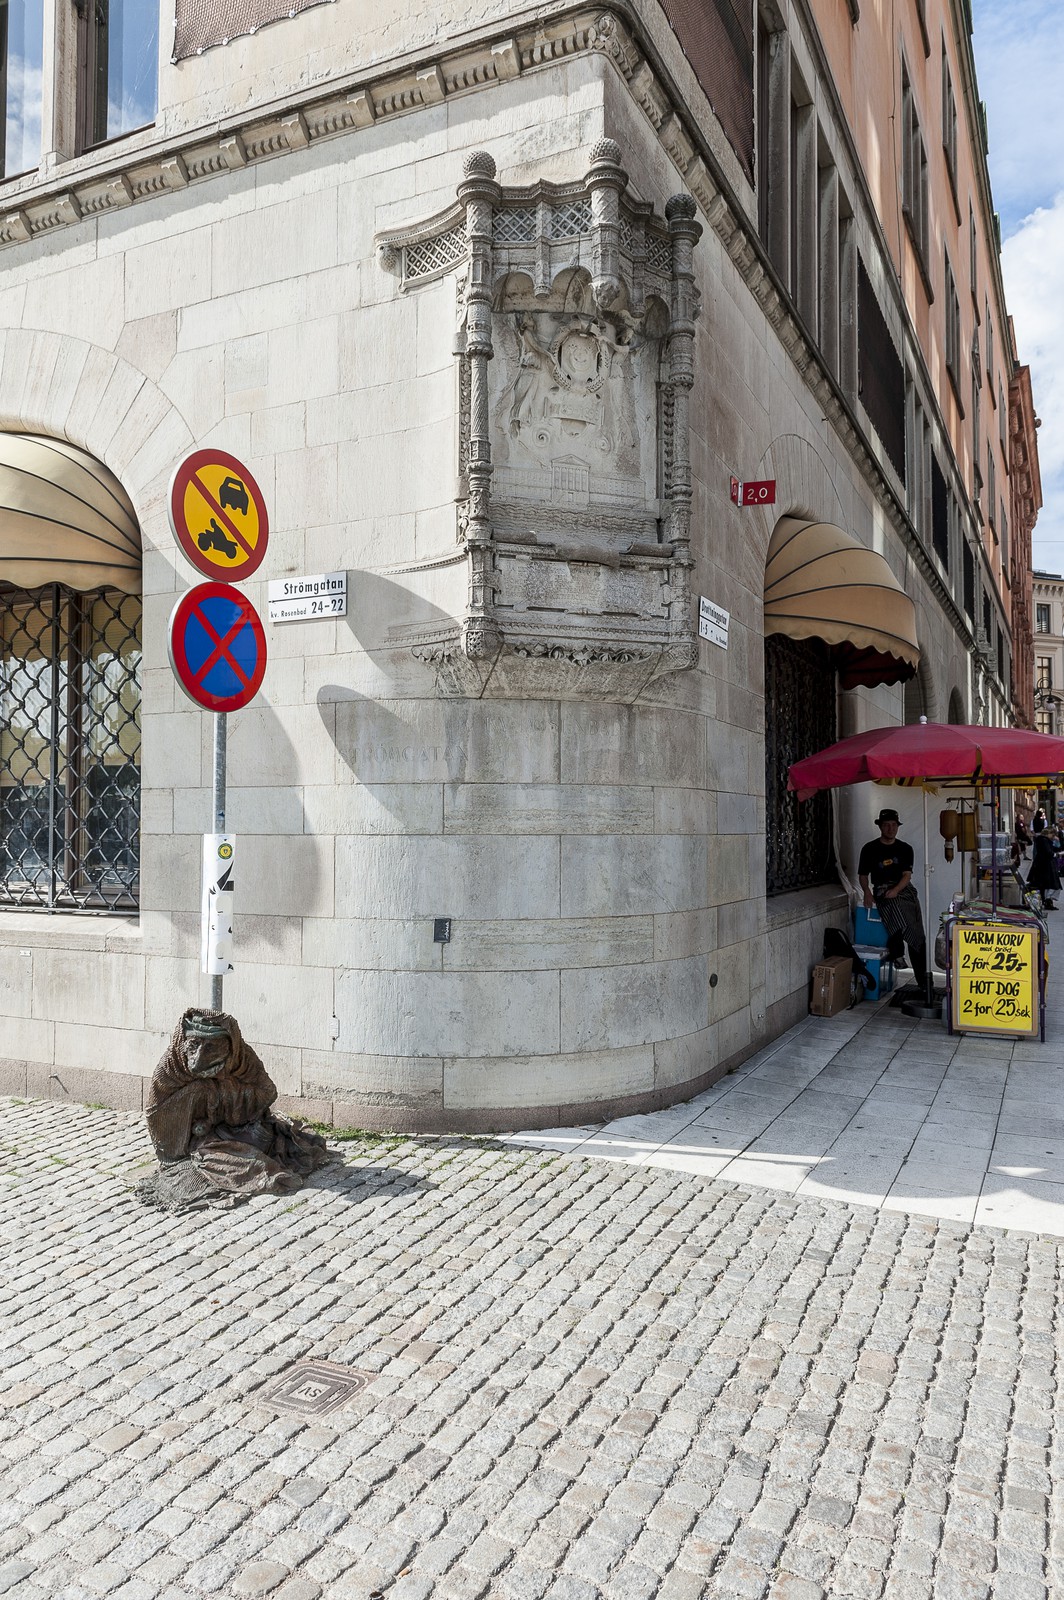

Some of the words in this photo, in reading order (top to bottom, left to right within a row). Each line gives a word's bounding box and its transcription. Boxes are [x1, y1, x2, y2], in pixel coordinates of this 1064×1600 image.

[747, 487, 768, 503] 2,0
[284, 579, 343, 595] Strömgatan
[311, 598, 344, 614] 24-22
[963, 931, 994, 945] VARM
[996, 933, 1024, 947] KORV
[961, 954, 971, 969] 2
[971, 957, 989, 972] för
[969, 980, 994, 995] HOT
[995, 981, 1020, 996] DOG
[963, 999, 973, 1013] 2
[974, 1002, 992, 1016] for
[995, 998, 1016, 1016] 25
[1015, 1005, 1031, 1018] sek
